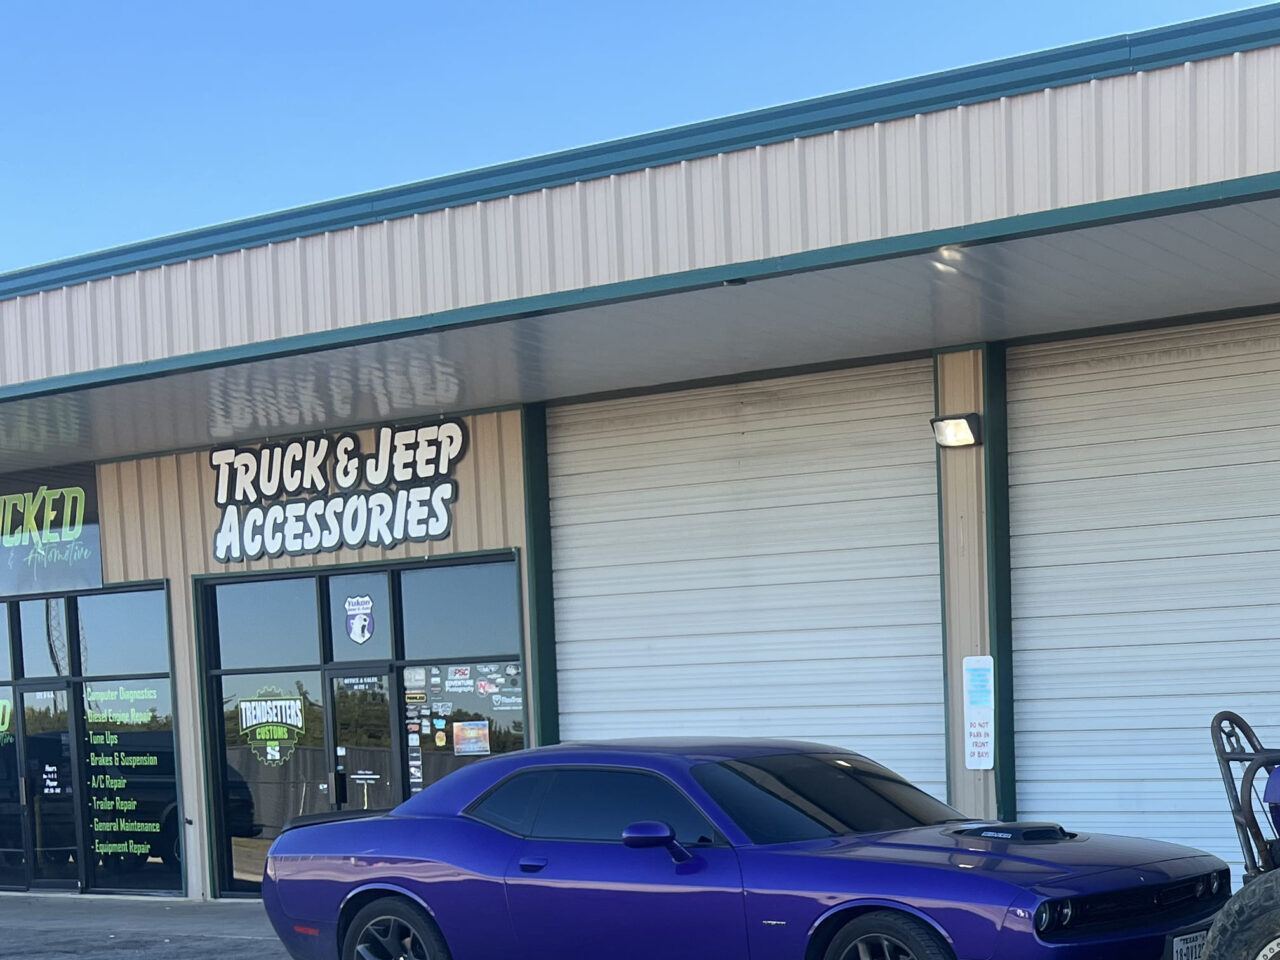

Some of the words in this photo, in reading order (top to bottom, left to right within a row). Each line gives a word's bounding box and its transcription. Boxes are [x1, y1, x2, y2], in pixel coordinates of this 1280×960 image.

[212, 438, 328, 503] TRUCK
[336, 437, 358, 488] &
[366, 423, 463, 485] JEEP
[216, 484, 452, 559] ACCESSORIES
[24, 541, 92, 581] Automotive
[87, 688, 118, 702] Computer
[119, 686, 157, 702] Diagnostics
[88, 710, 107, 722] Diesel
[109, 709, 130, 724] Engine
[131, 708, 152, 724] Repair
[240, 700, 302, 729] TRENDSETTERS
[89, 731, 105, 744] Tune
[106, 731, 118, 747] Ups
[256, 726, 288, 739] CUSTOMS
[91, 753, 113, 766] Brakes
[114, 753, 119, 765] &
[120, 753, 158, 768] Suspension
[92, 775, 105, 788] A/C
[106, 775, 127, 790] Repair
[92, 797, 115, 809] Trailer
[116, 797, 137, 812] Repair
[94, 818, 119, 831] General
[120, 819, 160, 832] Maintenance
[95, 840, 128, 854] Equipment
[129, 840, 151, 854] Repair
